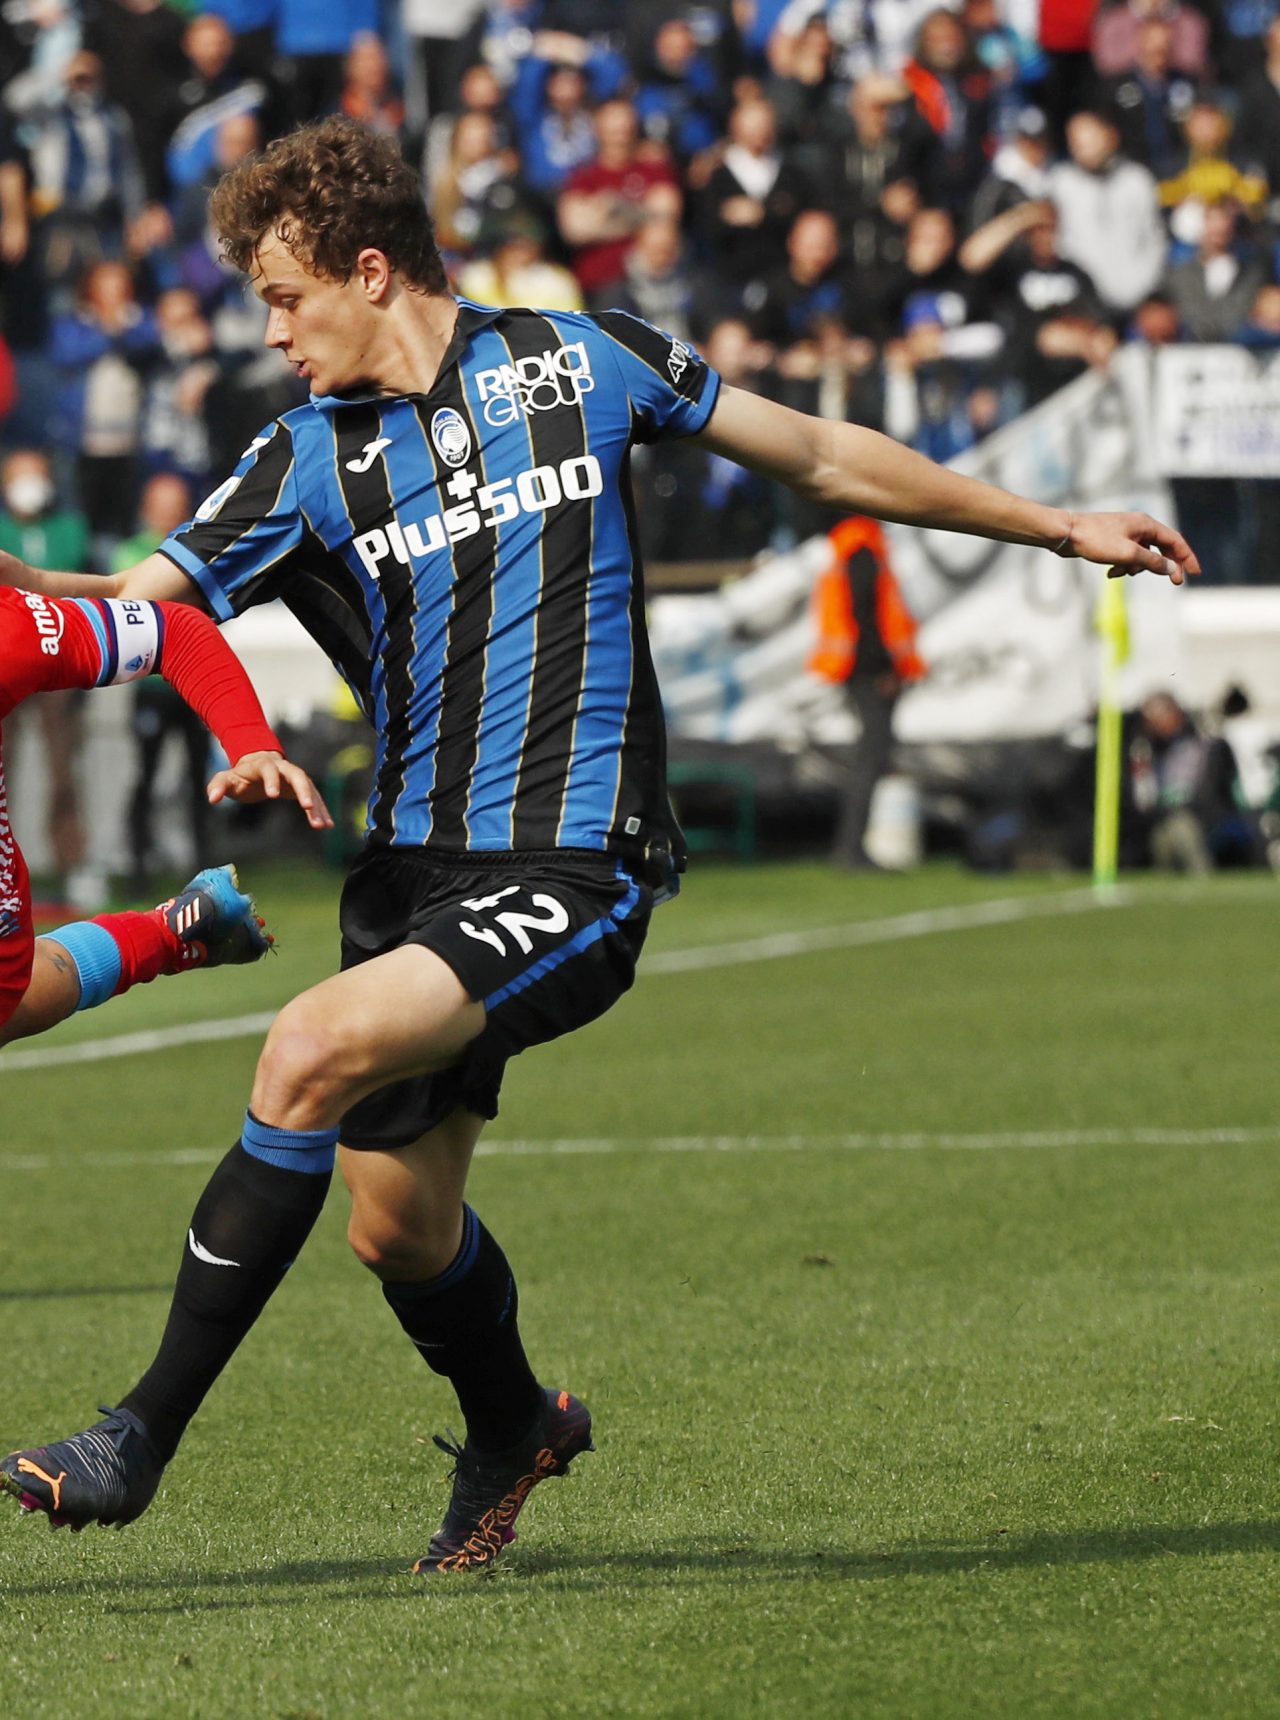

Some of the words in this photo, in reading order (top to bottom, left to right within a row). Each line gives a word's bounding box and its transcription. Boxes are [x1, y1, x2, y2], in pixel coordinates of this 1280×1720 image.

[475, 342, 590, 401] RADICI
[484, 374, 595, 427] GROUP
[352, 455, 603, 579] Plus500
